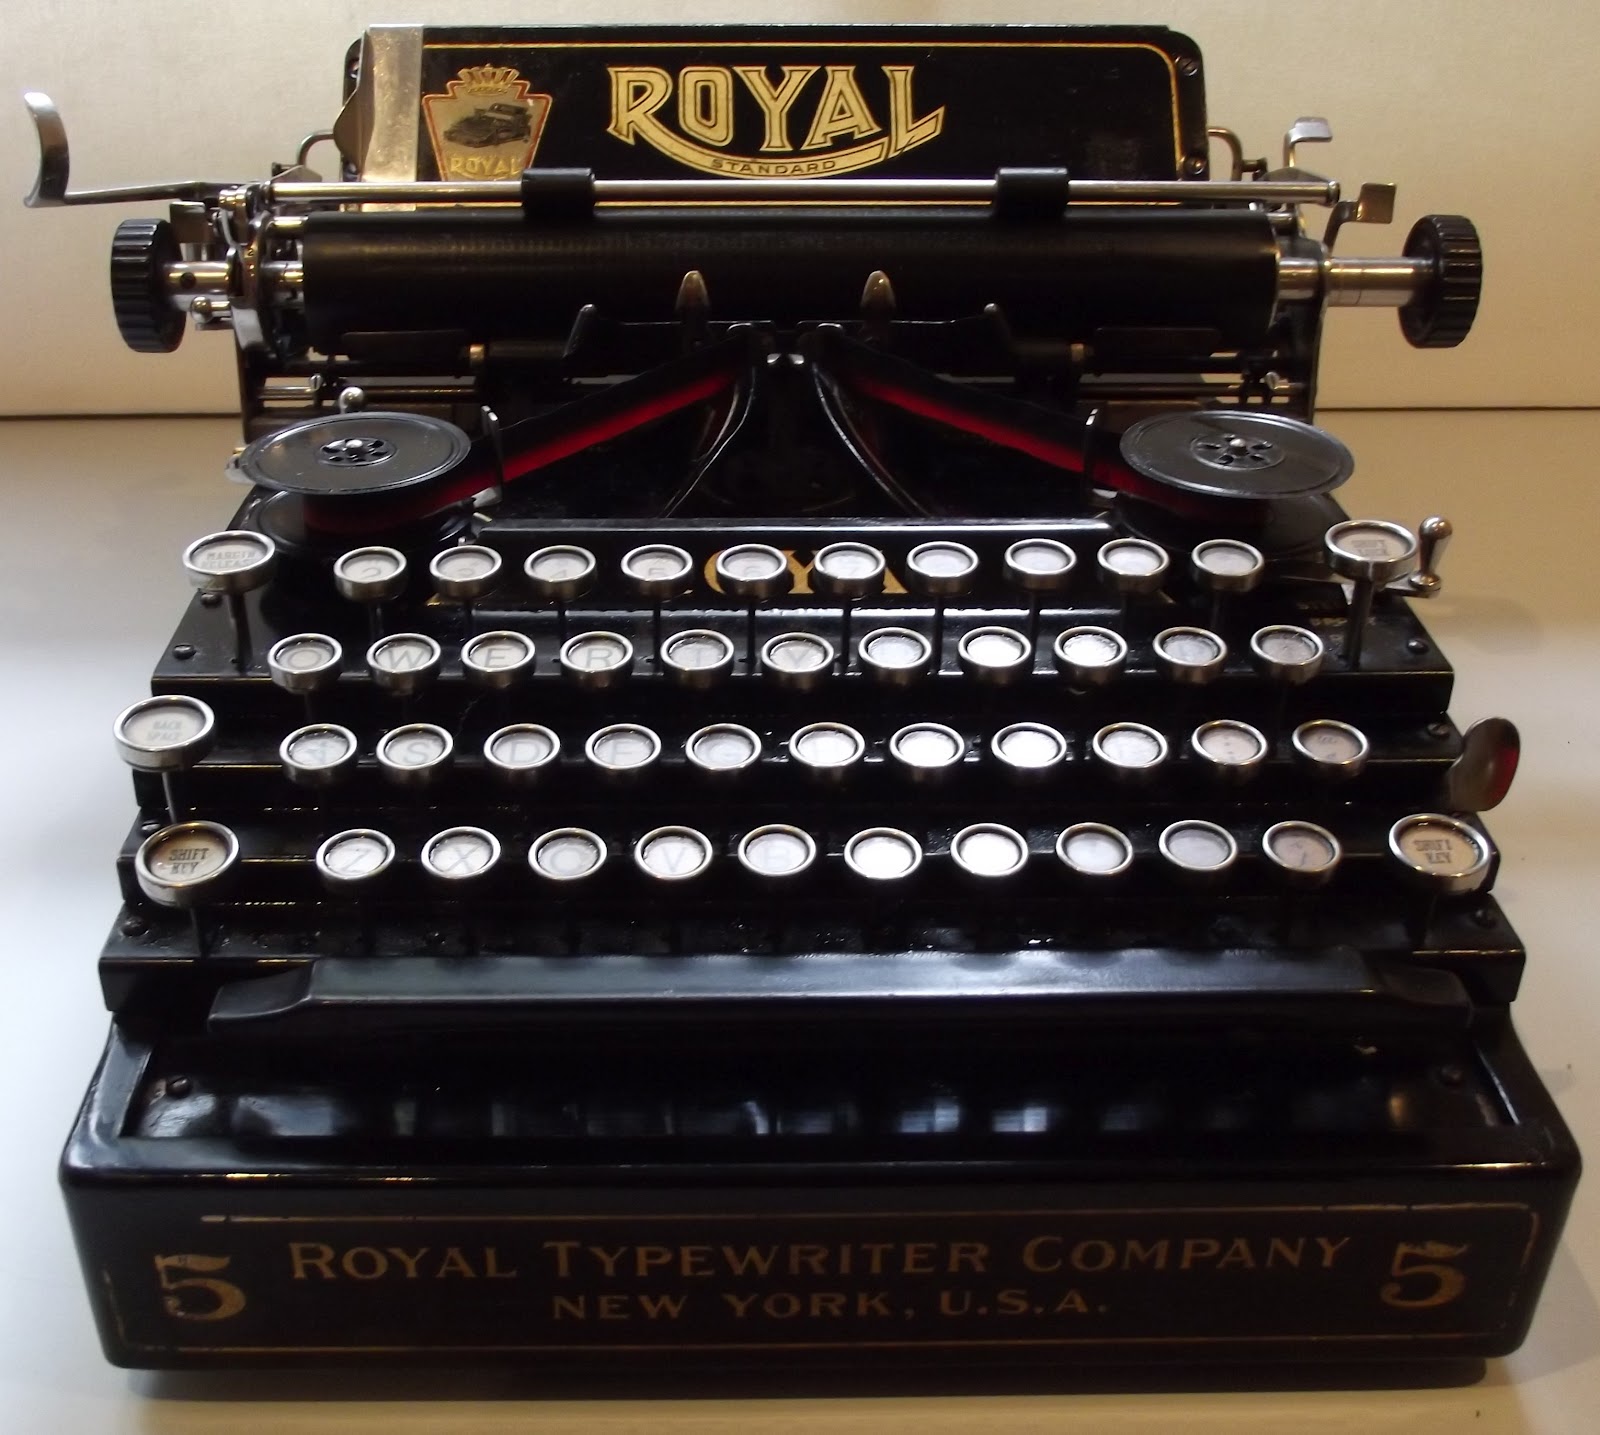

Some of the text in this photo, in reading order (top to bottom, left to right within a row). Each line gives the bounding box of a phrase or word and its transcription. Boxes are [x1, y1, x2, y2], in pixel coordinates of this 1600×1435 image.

[606, 65, 946, 178] ROYAL
[449, 157, 522, 177] ROYAL
[711, 159, 836, 175] STANDARD
[388, 647, 424, 668] W
[483, 647, 512, 669] E
[585, 647, 616, 670] R
[403, 740, 431, 764] S
[510, 739, 541, 764] D
[168, 847, 209, 862] SHIFT
[443, 844, 484, 872] X
[660, 845, 690, 872] V
[170, 861, 198, 875] KEY
[288, 1234, 1350, 1280] ROYAL TYPEWRITER COMPANY
[1380, 1241, 1468, 1308] 5
[154, 1254, 246, 1321] 5
[552, 1288, 1107, 1320] NEW YORK, U.S.A.
